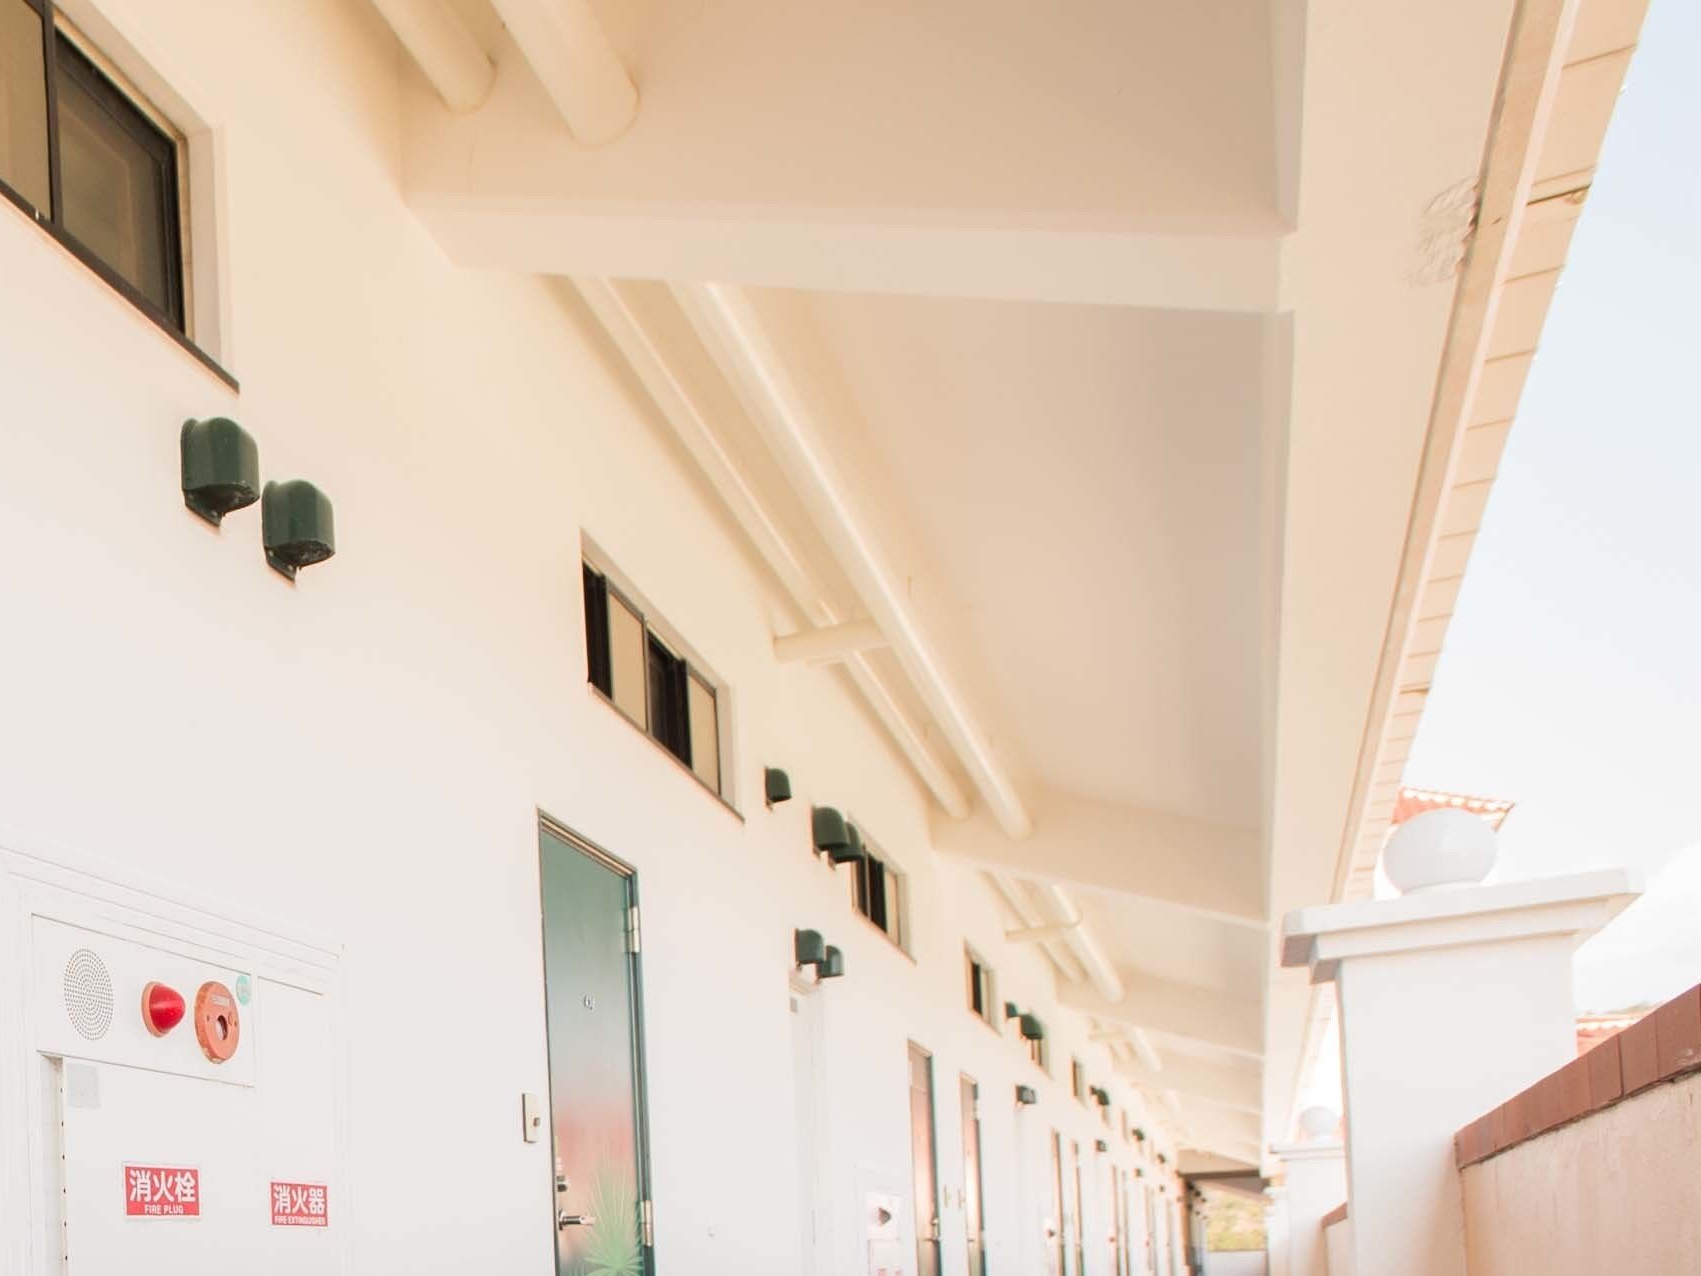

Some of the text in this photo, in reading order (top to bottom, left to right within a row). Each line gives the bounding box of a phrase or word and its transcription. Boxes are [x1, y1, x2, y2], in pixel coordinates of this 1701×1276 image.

[129, 1169, 196, 1203] 消火栓
[273, 1185, 325, 1215] 消火器
[144, 1204, 184, 1214] FIRE PLUG
